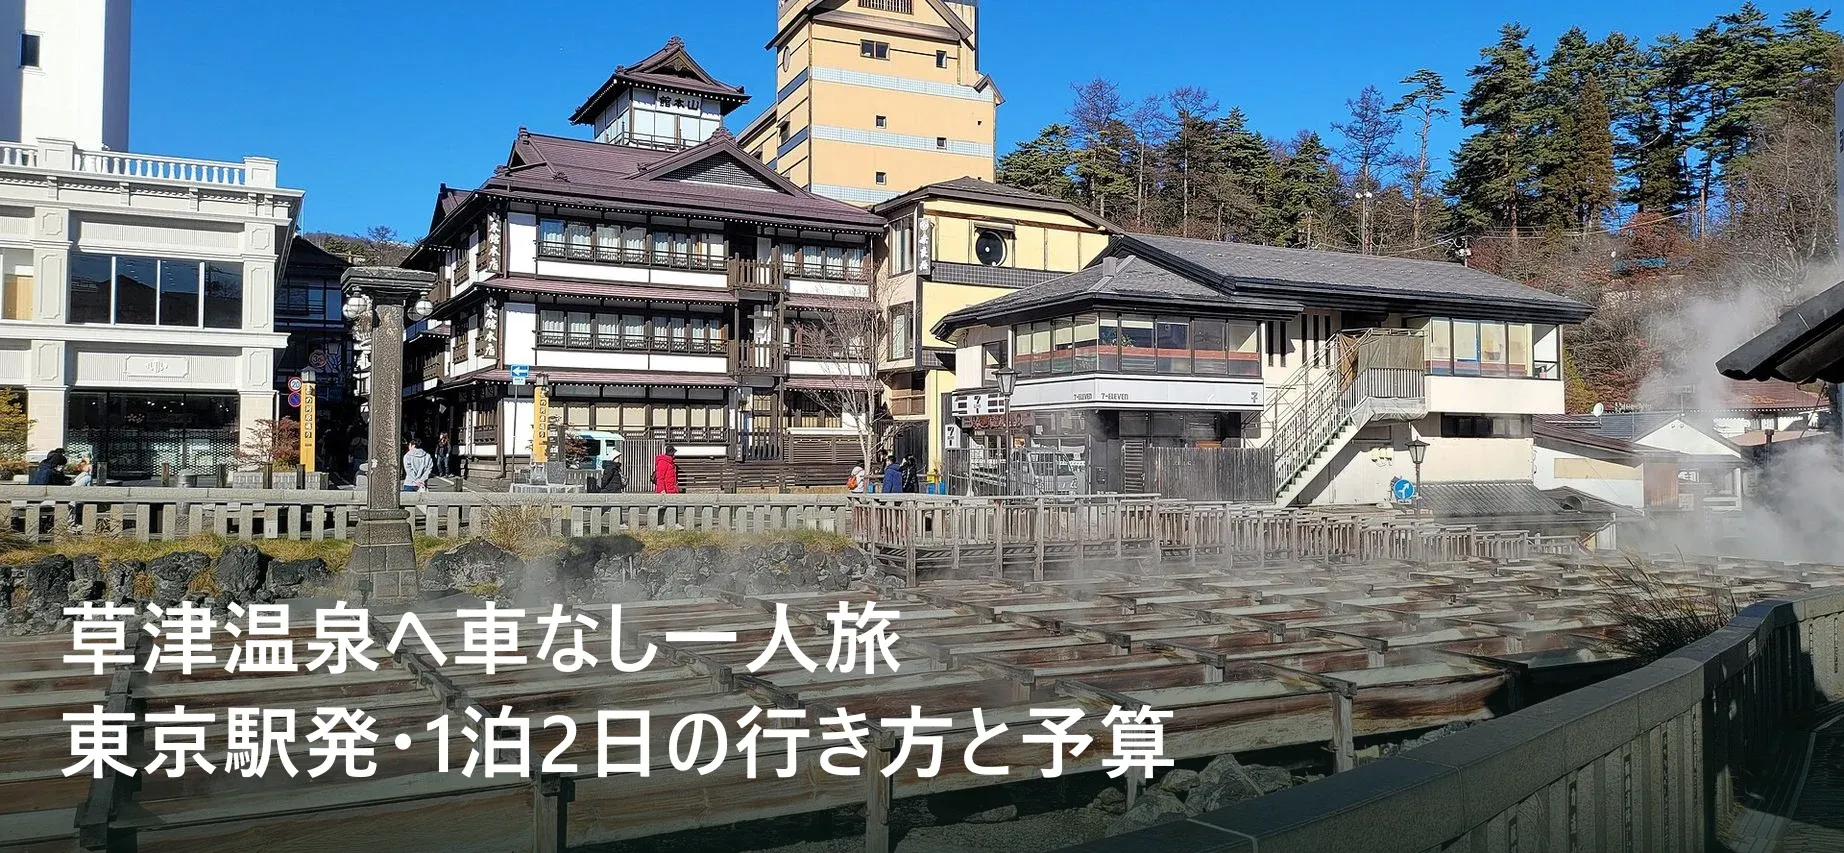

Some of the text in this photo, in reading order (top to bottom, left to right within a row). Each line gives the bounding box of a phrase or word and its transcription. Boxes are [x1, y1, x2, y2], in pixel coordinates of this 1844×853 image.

[489, 212, 501, 271] 山本館本店
[485, 297, 498, 356] 山本館本店
